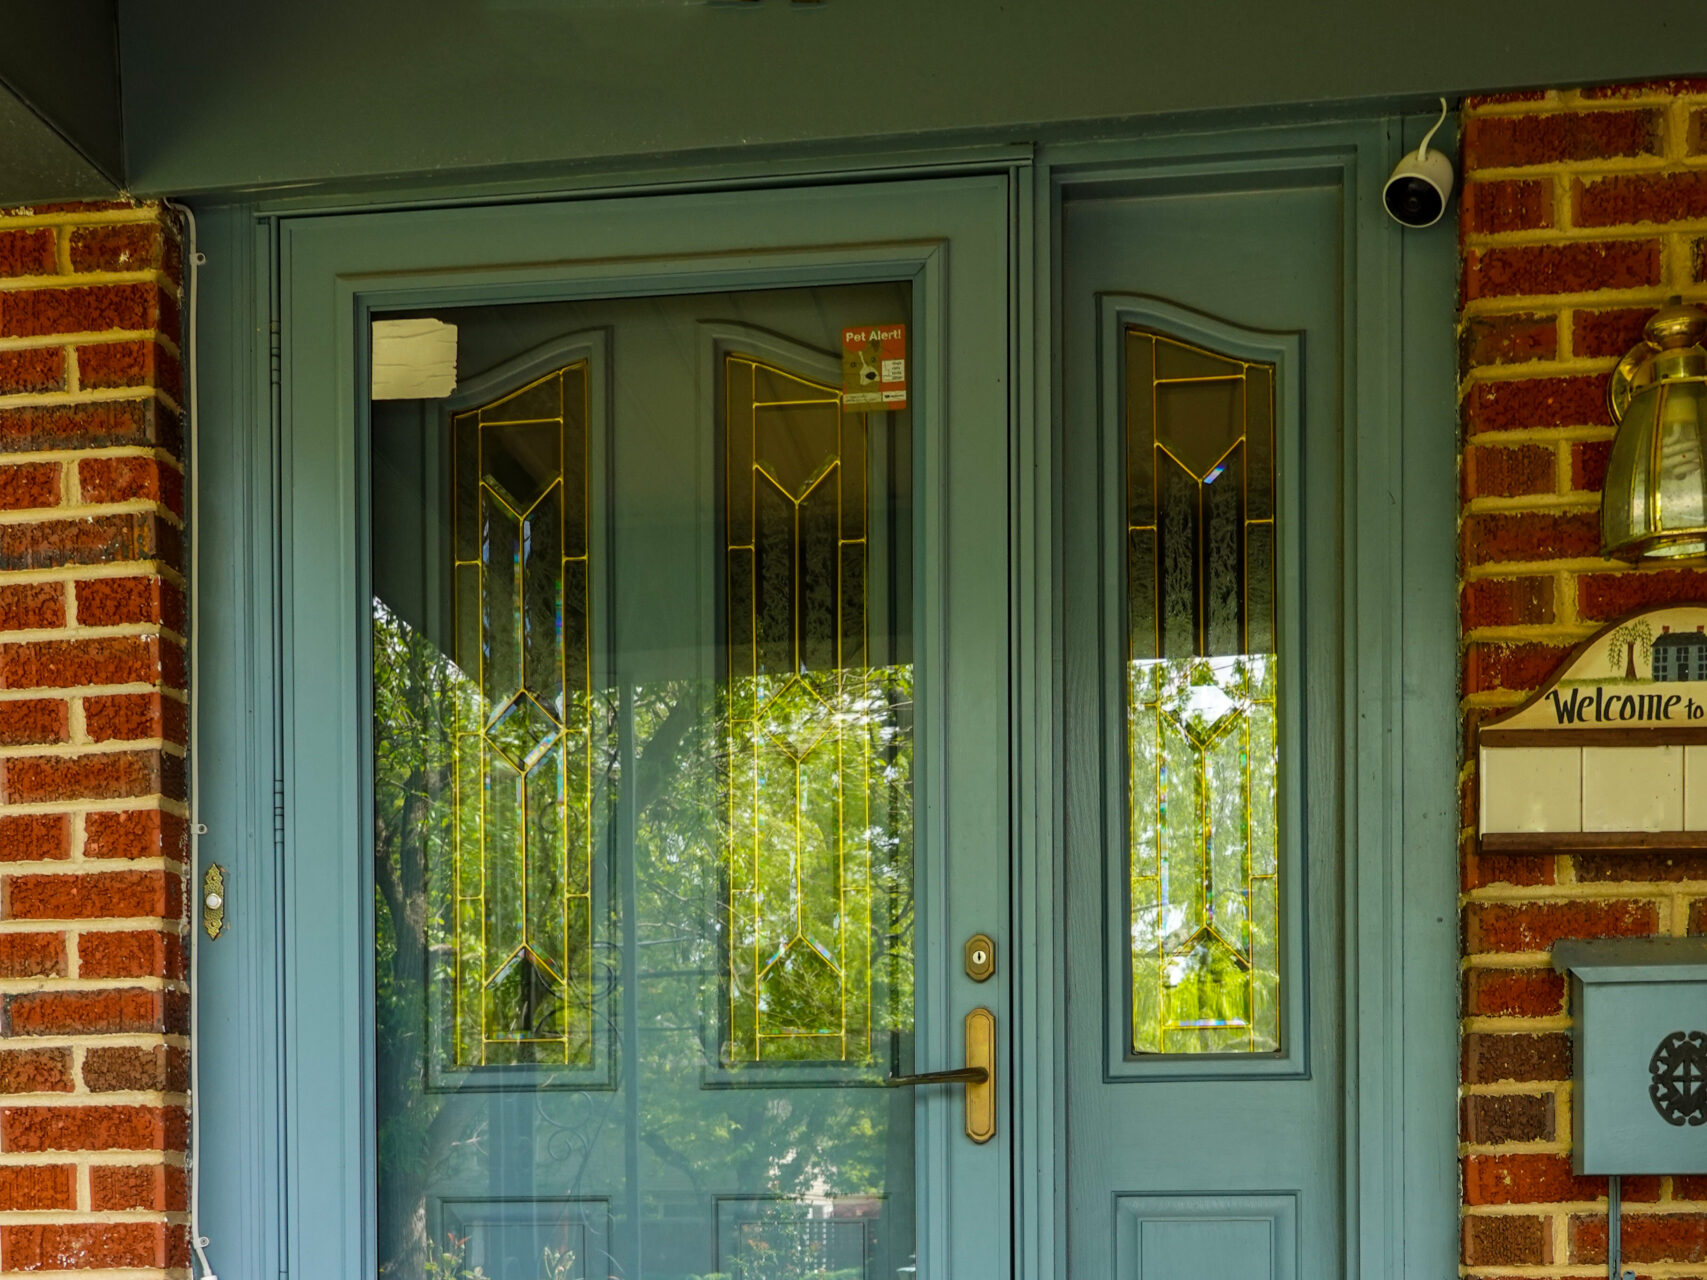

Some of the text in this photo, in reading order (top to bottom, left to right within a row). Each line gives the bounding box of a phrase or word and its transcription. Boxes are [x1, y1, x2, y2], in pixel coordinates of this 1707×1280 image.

[845, 329, 902, 342] Pet Alert!
[1545, 687, 1705, 724] Welcome to
